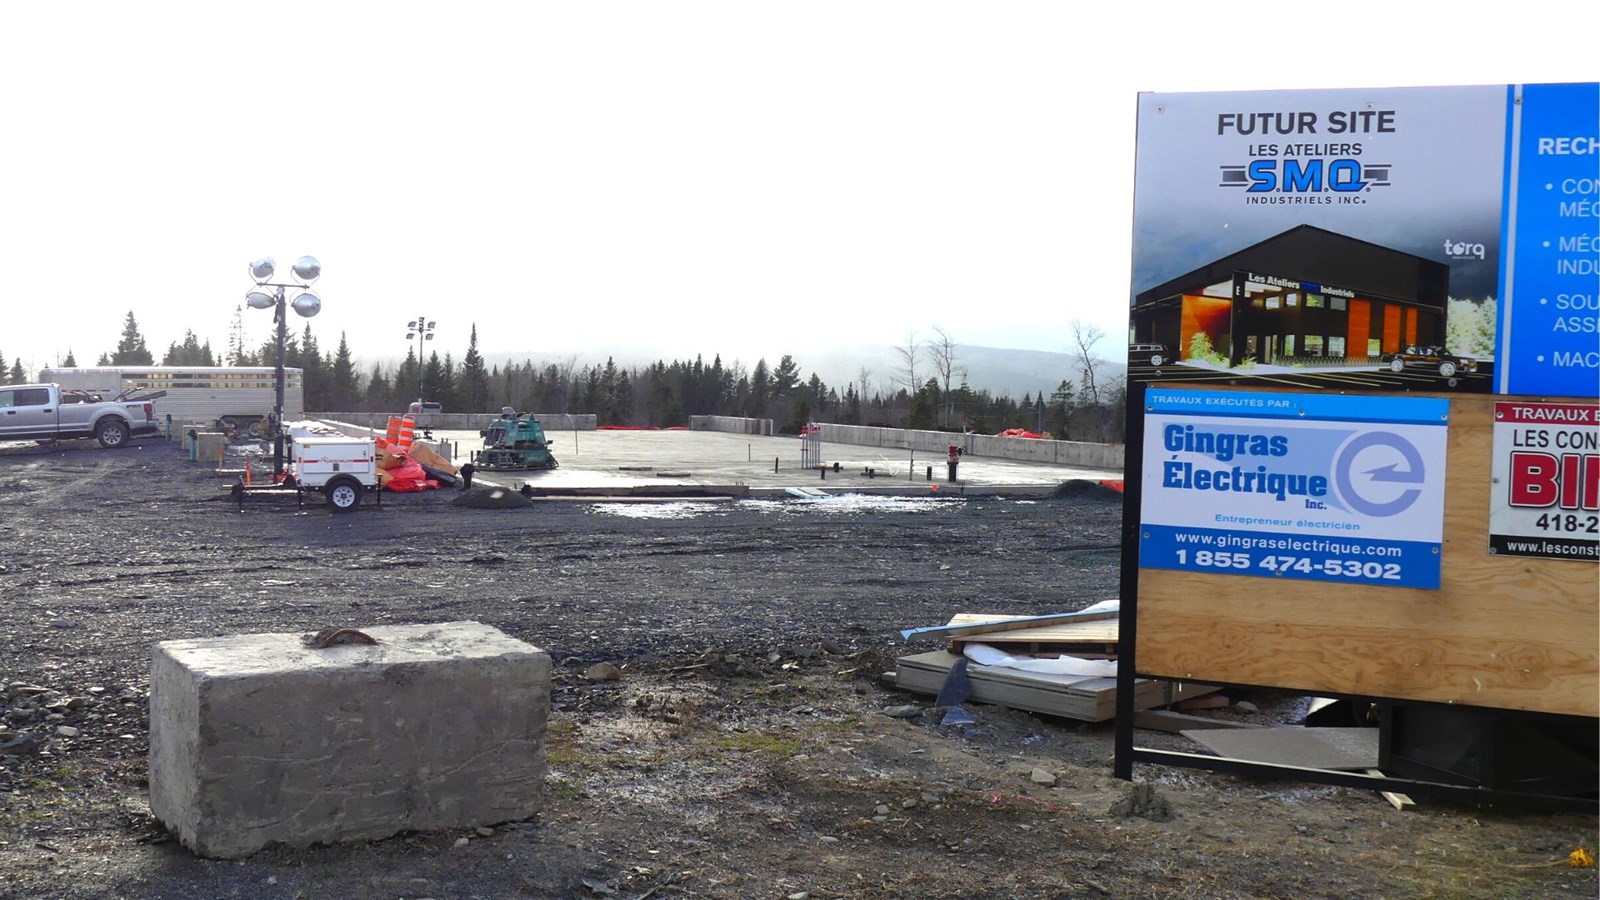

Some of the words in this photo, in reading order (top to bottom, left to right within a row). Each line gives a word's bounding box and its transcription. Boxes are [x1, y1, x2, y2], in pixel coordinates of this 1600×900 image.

[1217, 112, 1318, 135] FUTUR
[1327, 110, 1396, 134] SITE
[1248, 144, 1279, 157] LES
[1283, 143, 1363, 157] ATELIERS
[1537, 136, 1600, 155] RECH
[1246, 196, 1332, 205] INDUSTRIELS
[1443, 239, 1485, 260] torq
[1248, 272, 1266, 284] Les
[1266, 275, 1300, 290] Ateliers
[1320, 285, 1355, 298] Industriels
[1552, 316, 1600, 333] ASS
[1152, 395, 1202, 405] TRAVAUX
[1205, 396, 1264, 408] EXÉCUTÉS
[1267, 400, 1290, 408] PAR
[1512, 407, 1590, 421] TRAVAUX
[1164, 424, 1288, 462] Gingras
[1513, 429, 1550, 448] LES
[1162, 455, 1328, 502] Électrique
[1305, 499, 1327, 510] Inc.
[1214, 514, 1293, 527] Entrepreneur
[1296, 518, 1361, 531] électricien
[1535, 513, 1600, 534] 418-2
[1175, 532, 1402, 557] www.gingraselectrique.com
[1176, 549, 1187, 564] 1
[1195, 550, 1251, 569] 855
[1258, 555, 1401, 580] 474-5302
